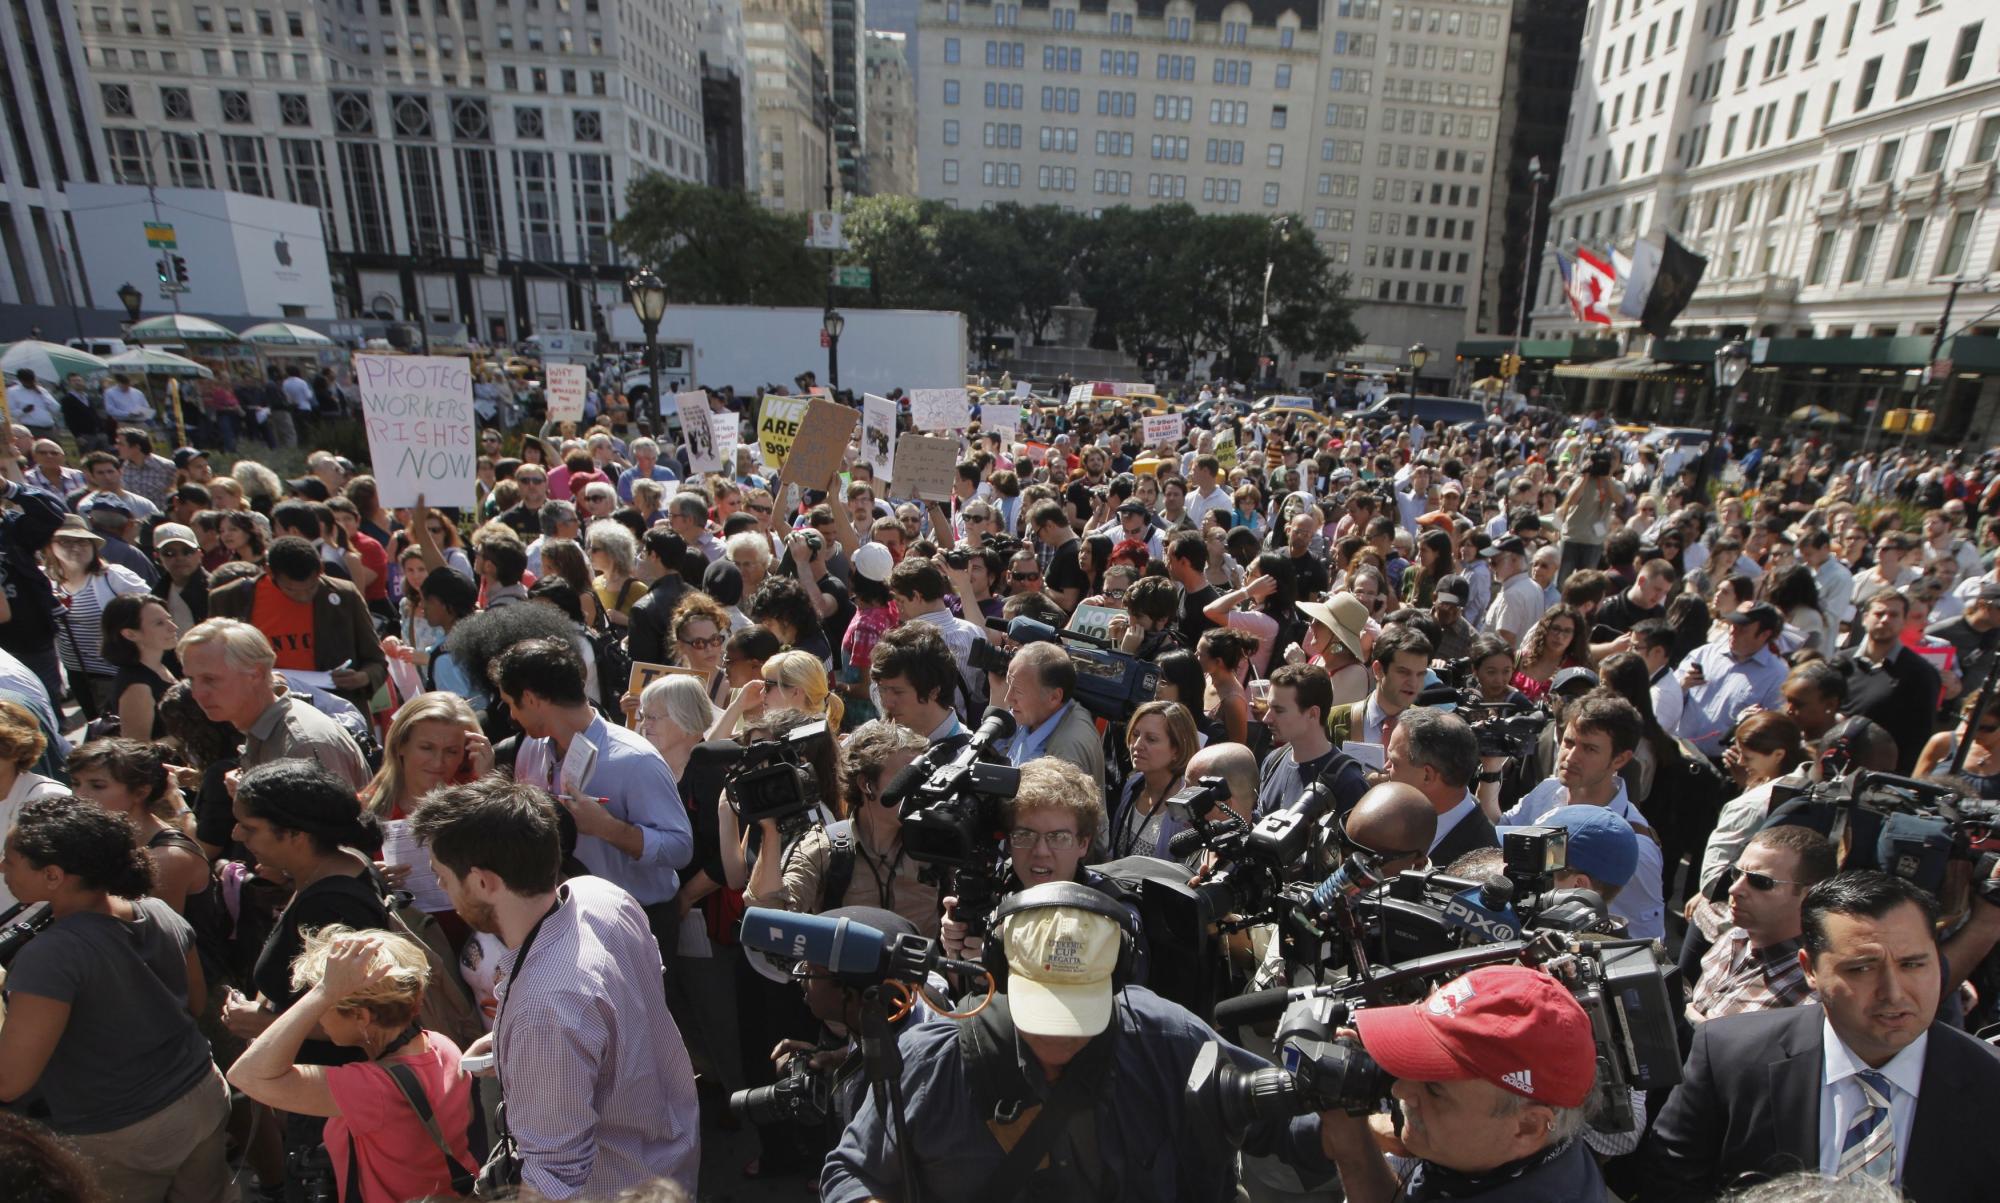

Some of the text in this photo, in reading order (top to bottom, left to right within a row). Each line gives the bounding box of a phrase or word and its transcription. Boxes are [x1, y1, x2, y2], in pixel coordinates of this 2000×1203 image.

[358, 357, 469, 395] PROTECT
[549, 367, 572, 377] WHY
[362, 393, 468, 423] WORKERS
[766, 399, 802, 421] WE
[366, 417, 471, 447] RIGHTS
[762, 418, 799, 437] ARE
[396, 447, 471, 481] NOW
[271, 633, 311, 650] NYC
[1446, 901, 1496, 934] PIX
[1055, 948, 1076, 956] CUP
[1501, 1074, 1534, 1094] adidas
